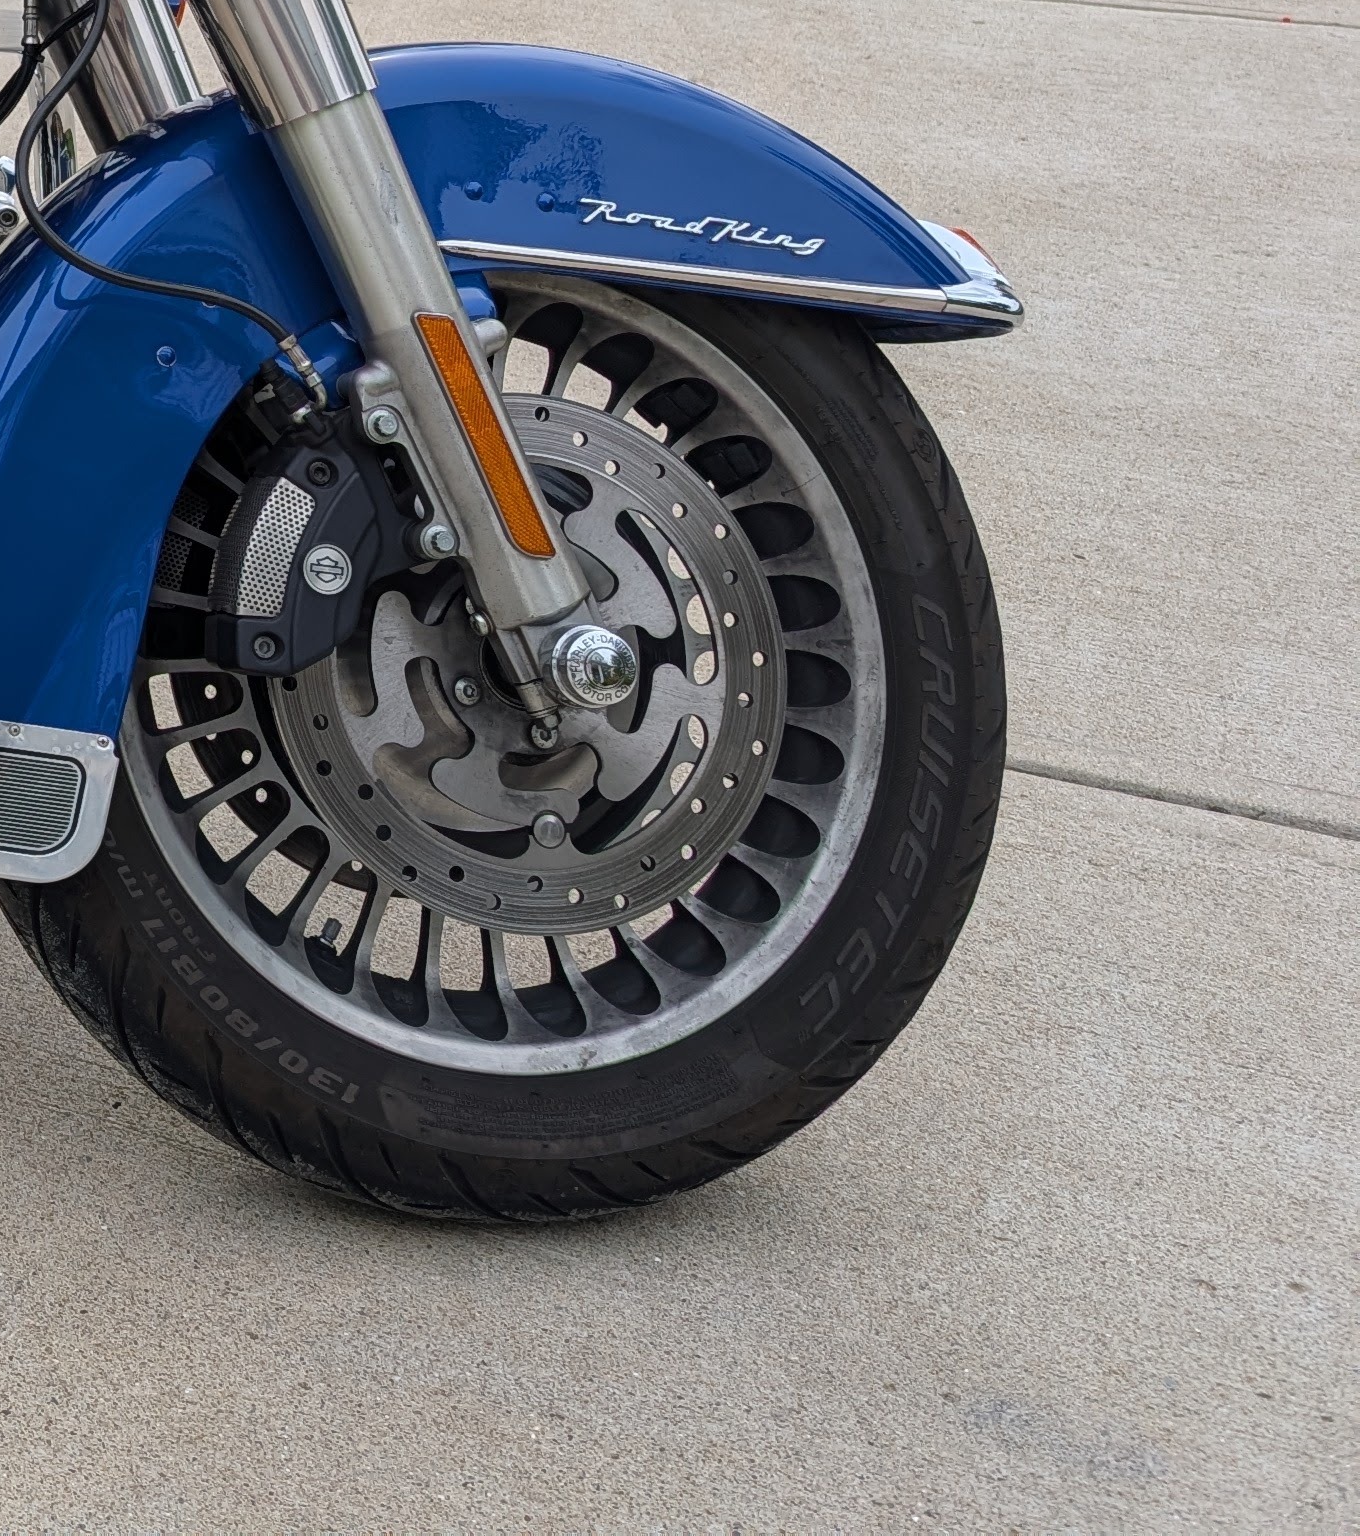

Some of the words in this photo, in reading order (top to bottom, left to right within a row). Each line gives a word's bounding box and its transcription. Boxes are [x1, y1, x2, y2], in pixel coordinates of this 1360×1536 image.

[574, 679, 613, 702] MOTOR
[799, 593, 957, 1035] CRUISETEC
[142, 869, 218, 963] FRONT
[140, 917, 361, 1105] 130/80B17
